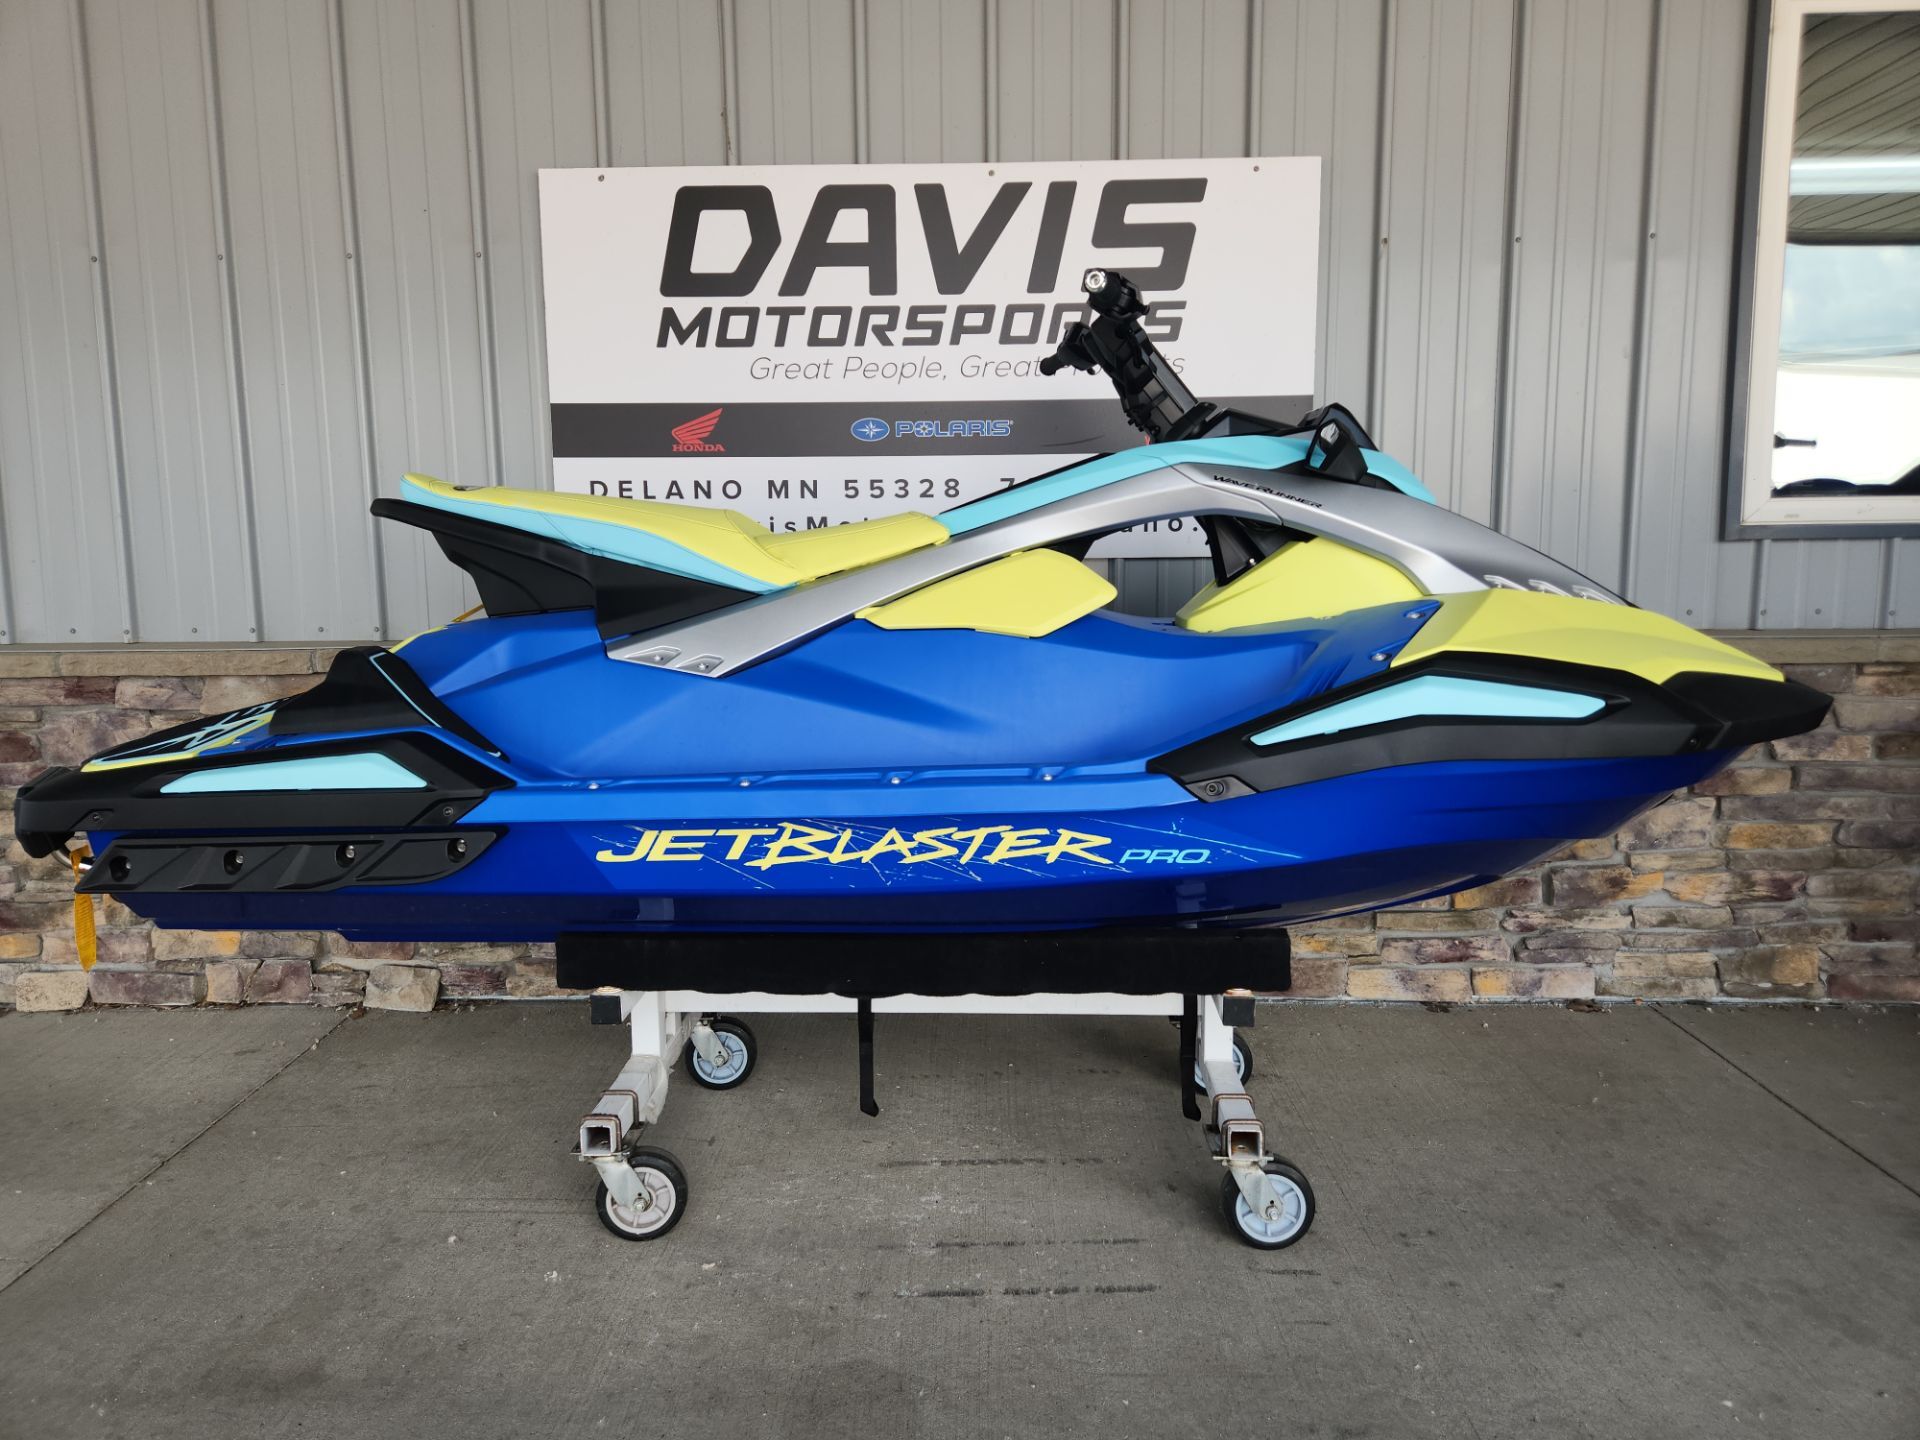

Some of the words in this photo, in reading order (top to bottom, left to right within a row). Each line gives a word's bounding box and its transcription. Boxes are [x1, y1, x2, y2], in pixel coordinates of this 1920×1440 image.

[659, 177, 1208, 297] DAVIS
[656, 301, 1187, 348] MOTORSPORS
[750, 356, 834, 380] Great
[843, 355, 947, 385] People,
[960, 355, 1043, 378] Great
[672, 443, 726, 452] HONDA
[590, 479, 742, 500] DELANO
[767, 479, 819, 499] MN
[843, 478, 960, 499] 55328
